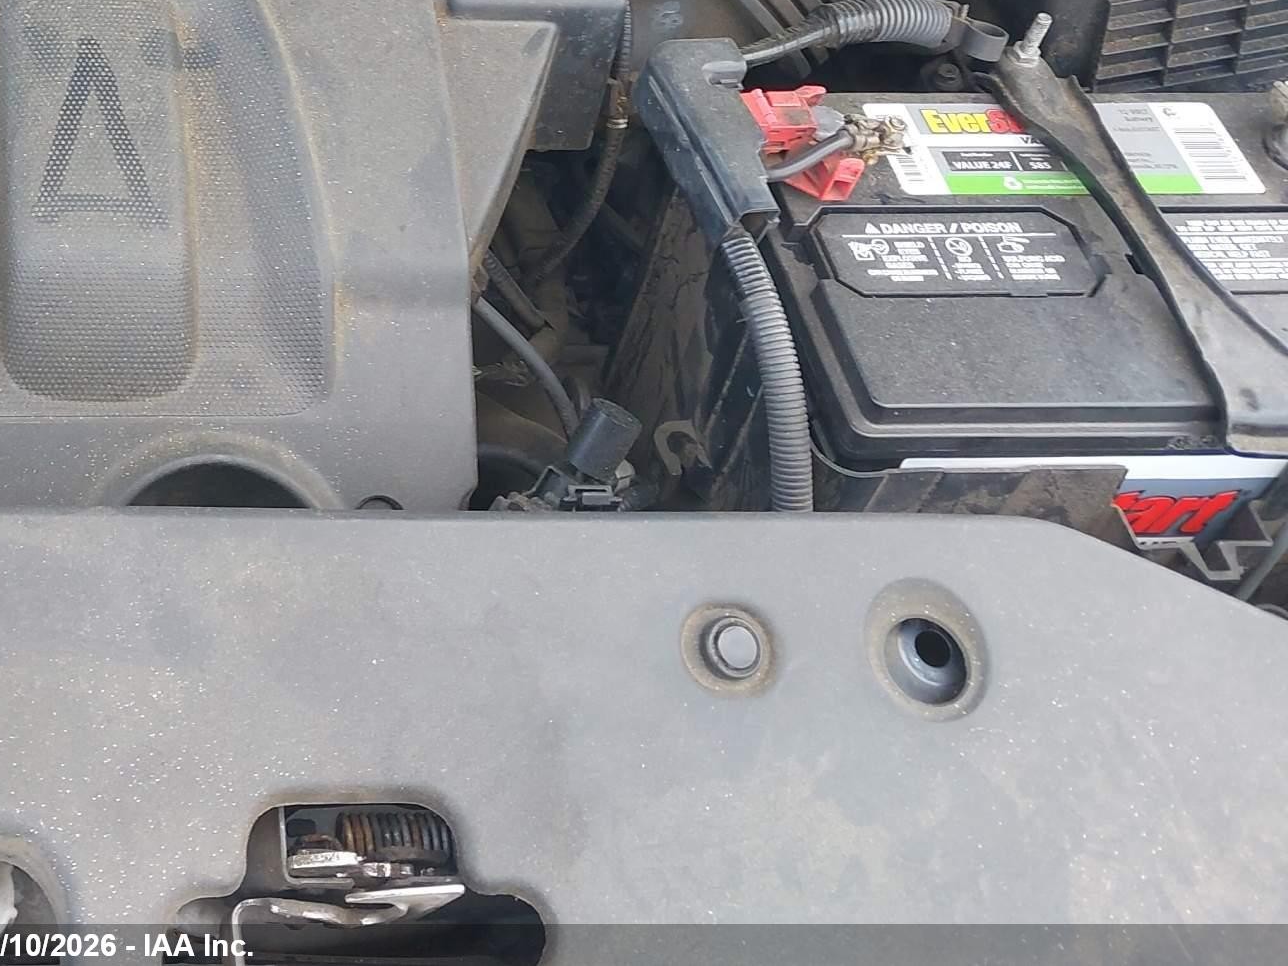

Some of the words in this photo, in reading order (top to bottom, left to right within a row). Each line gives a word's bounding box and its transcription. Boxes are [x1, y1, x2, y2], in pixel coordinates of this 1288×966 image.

[951, 160, 991, 170] VALUE
[879, 222, 946, 234] DANGER
[964, 222, 1024, 233] POISON
